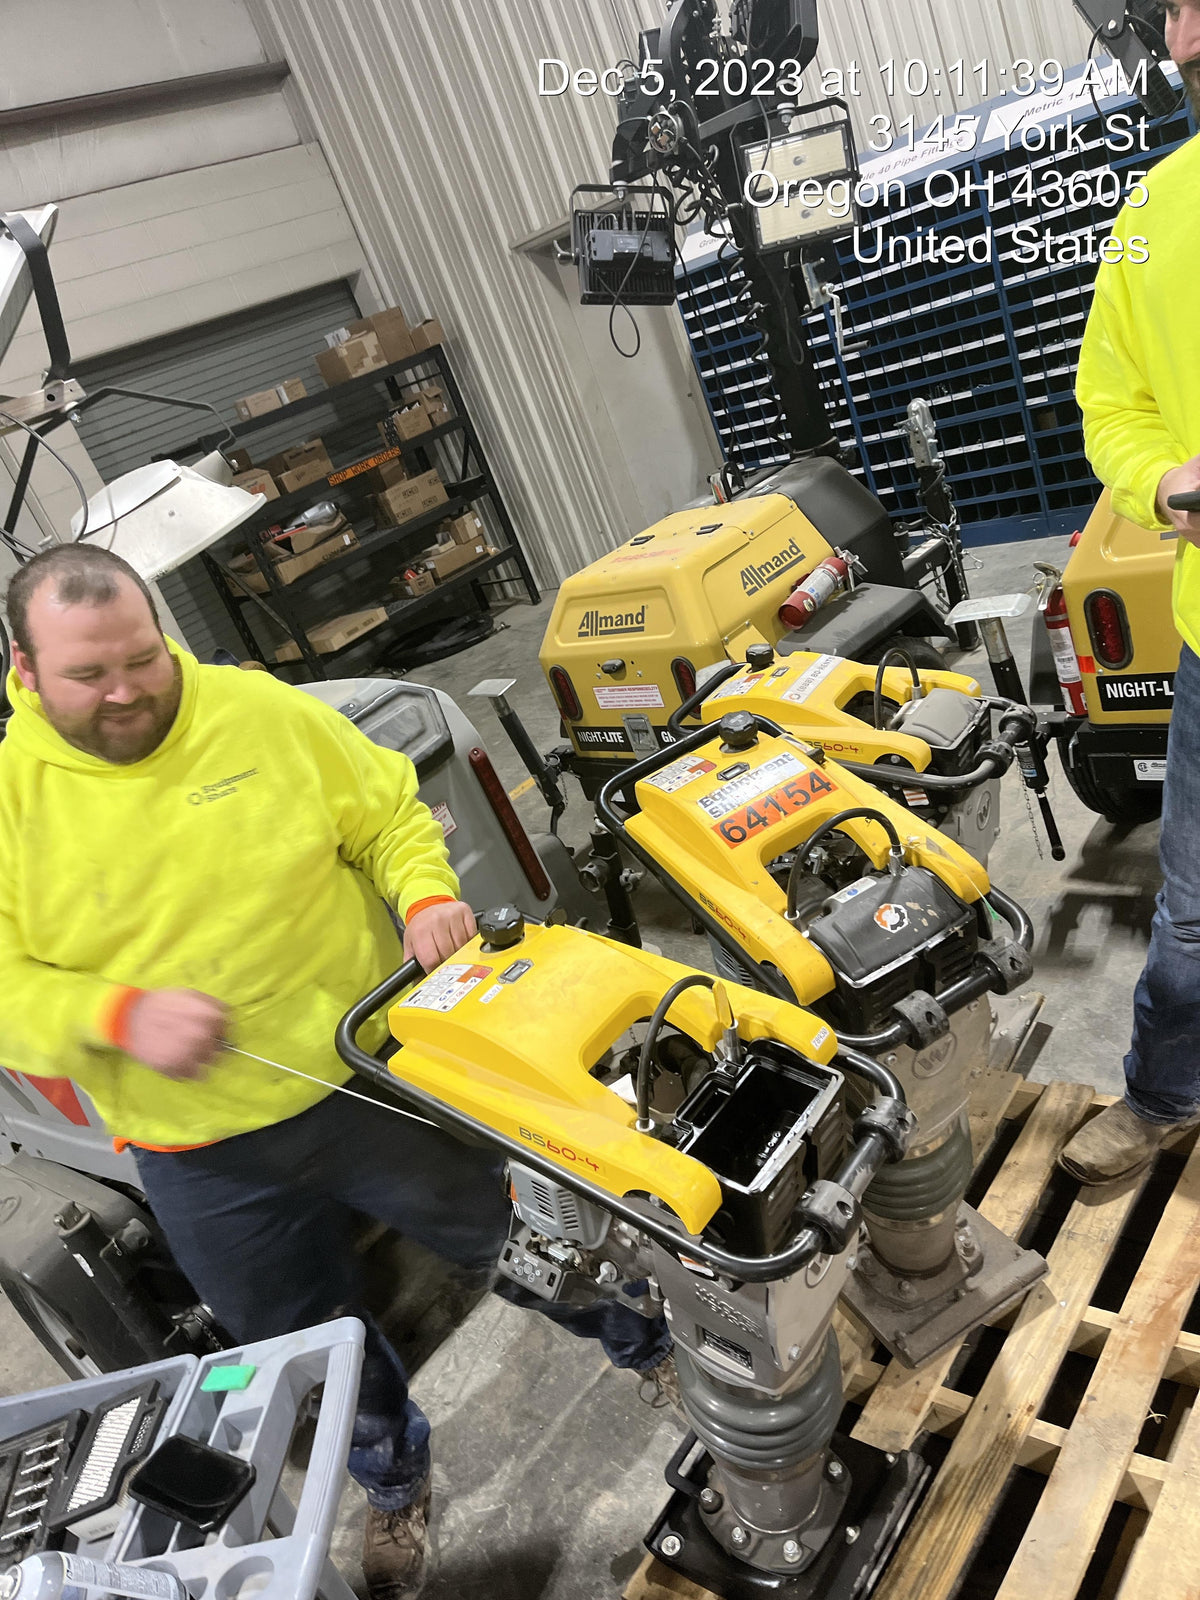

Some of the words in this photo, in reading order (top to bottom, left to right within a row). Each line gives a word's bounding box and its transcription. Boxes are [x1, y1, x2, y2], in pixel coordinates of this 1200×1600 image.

[1024, 97, 1064, 118] Metric
[893, 154, 918, 170] Pipe
[920, 137, 964, 157] Fittngs
[330, 470, 348, 487] SHOP
[352, 460, 371, 476] WORK
[373, 447, 401, 464] ORDERS
[740, 539, 803, 594] Allmand
[578, 605, 646, 636] Allmand
[577, 731, 624, 743] NIGHT-LITE
[698, 753, 795, 809] Equipment
[719, 771, 833, 844] 64154
[699, 892, 749, 940] BS60-4
[518, 1125, 601, 1173] BS60-4
